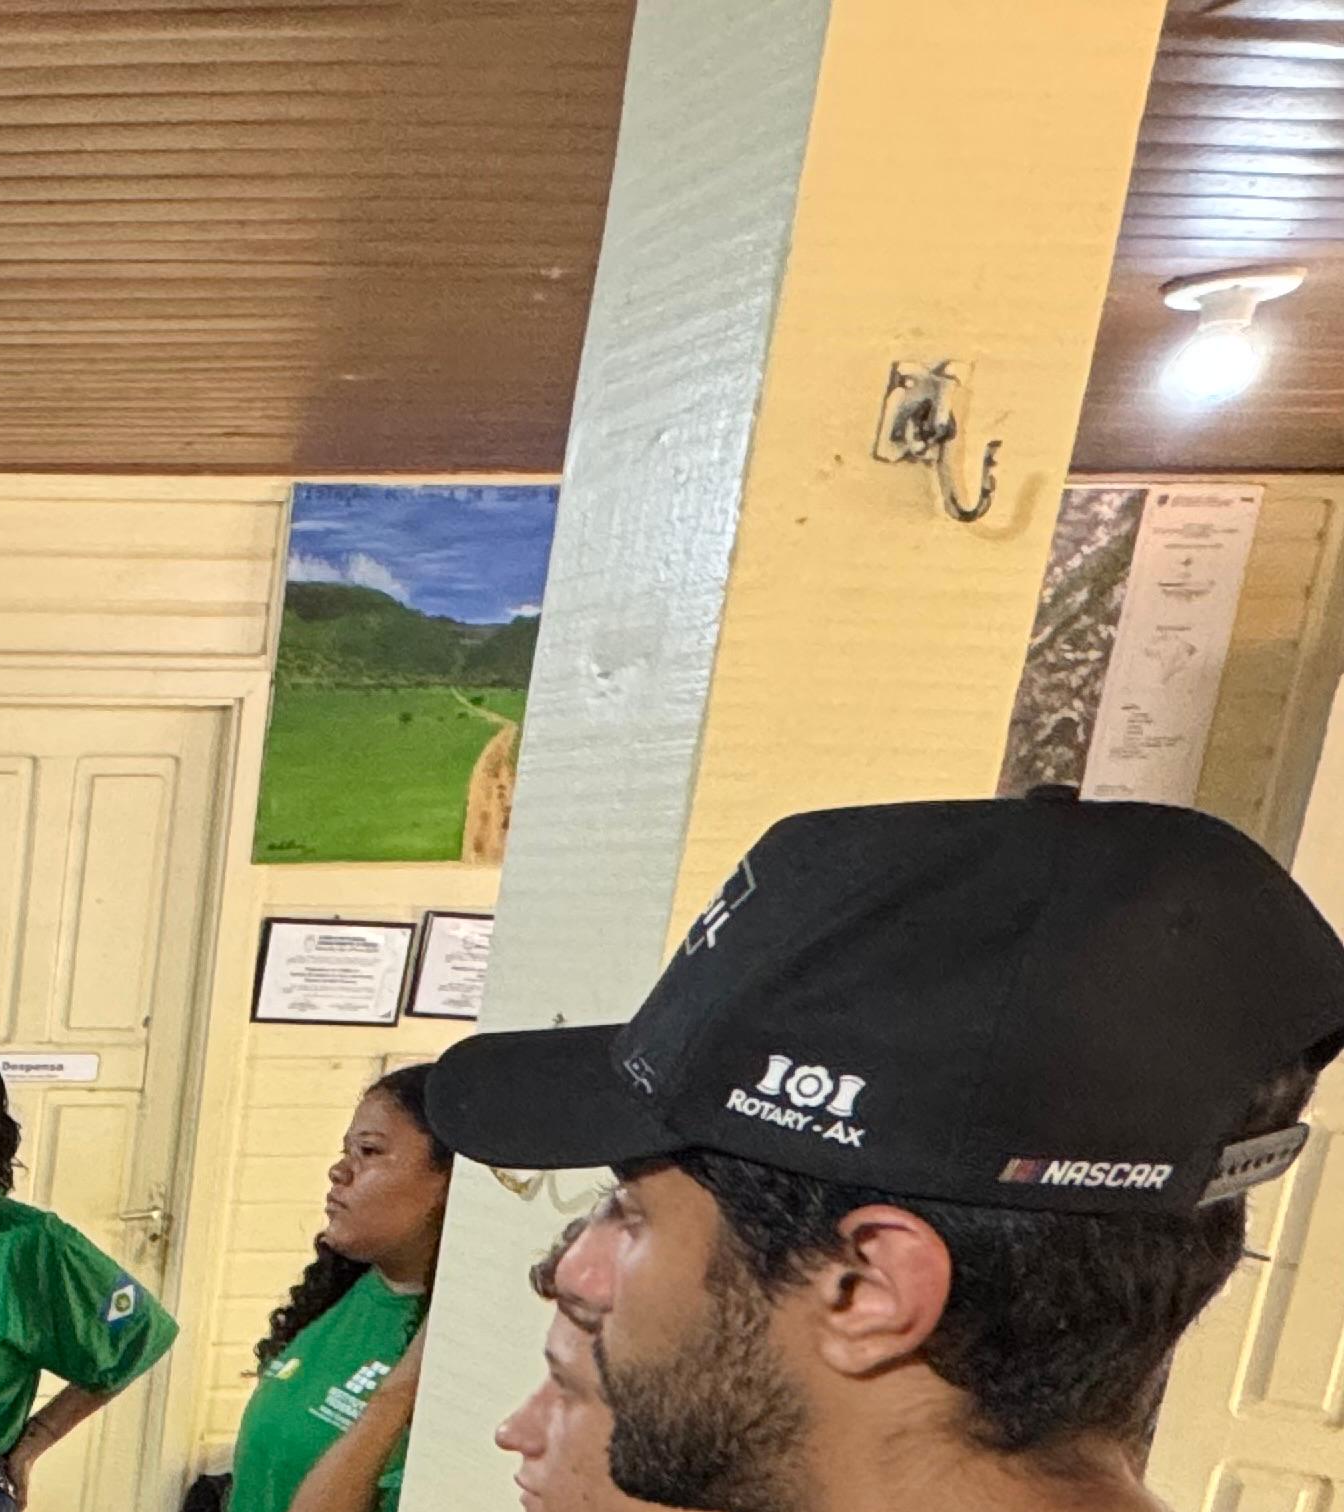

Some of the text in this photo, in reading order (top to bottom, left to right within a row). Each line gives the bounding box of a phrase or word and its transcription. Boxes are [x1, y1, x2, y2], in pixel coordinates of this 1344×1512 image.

[726, 1088, 814, 1132] ROTARY
[822, 1120, 866, 1148] AX
[1040, 1160, 1174, 1190] NASCAR
